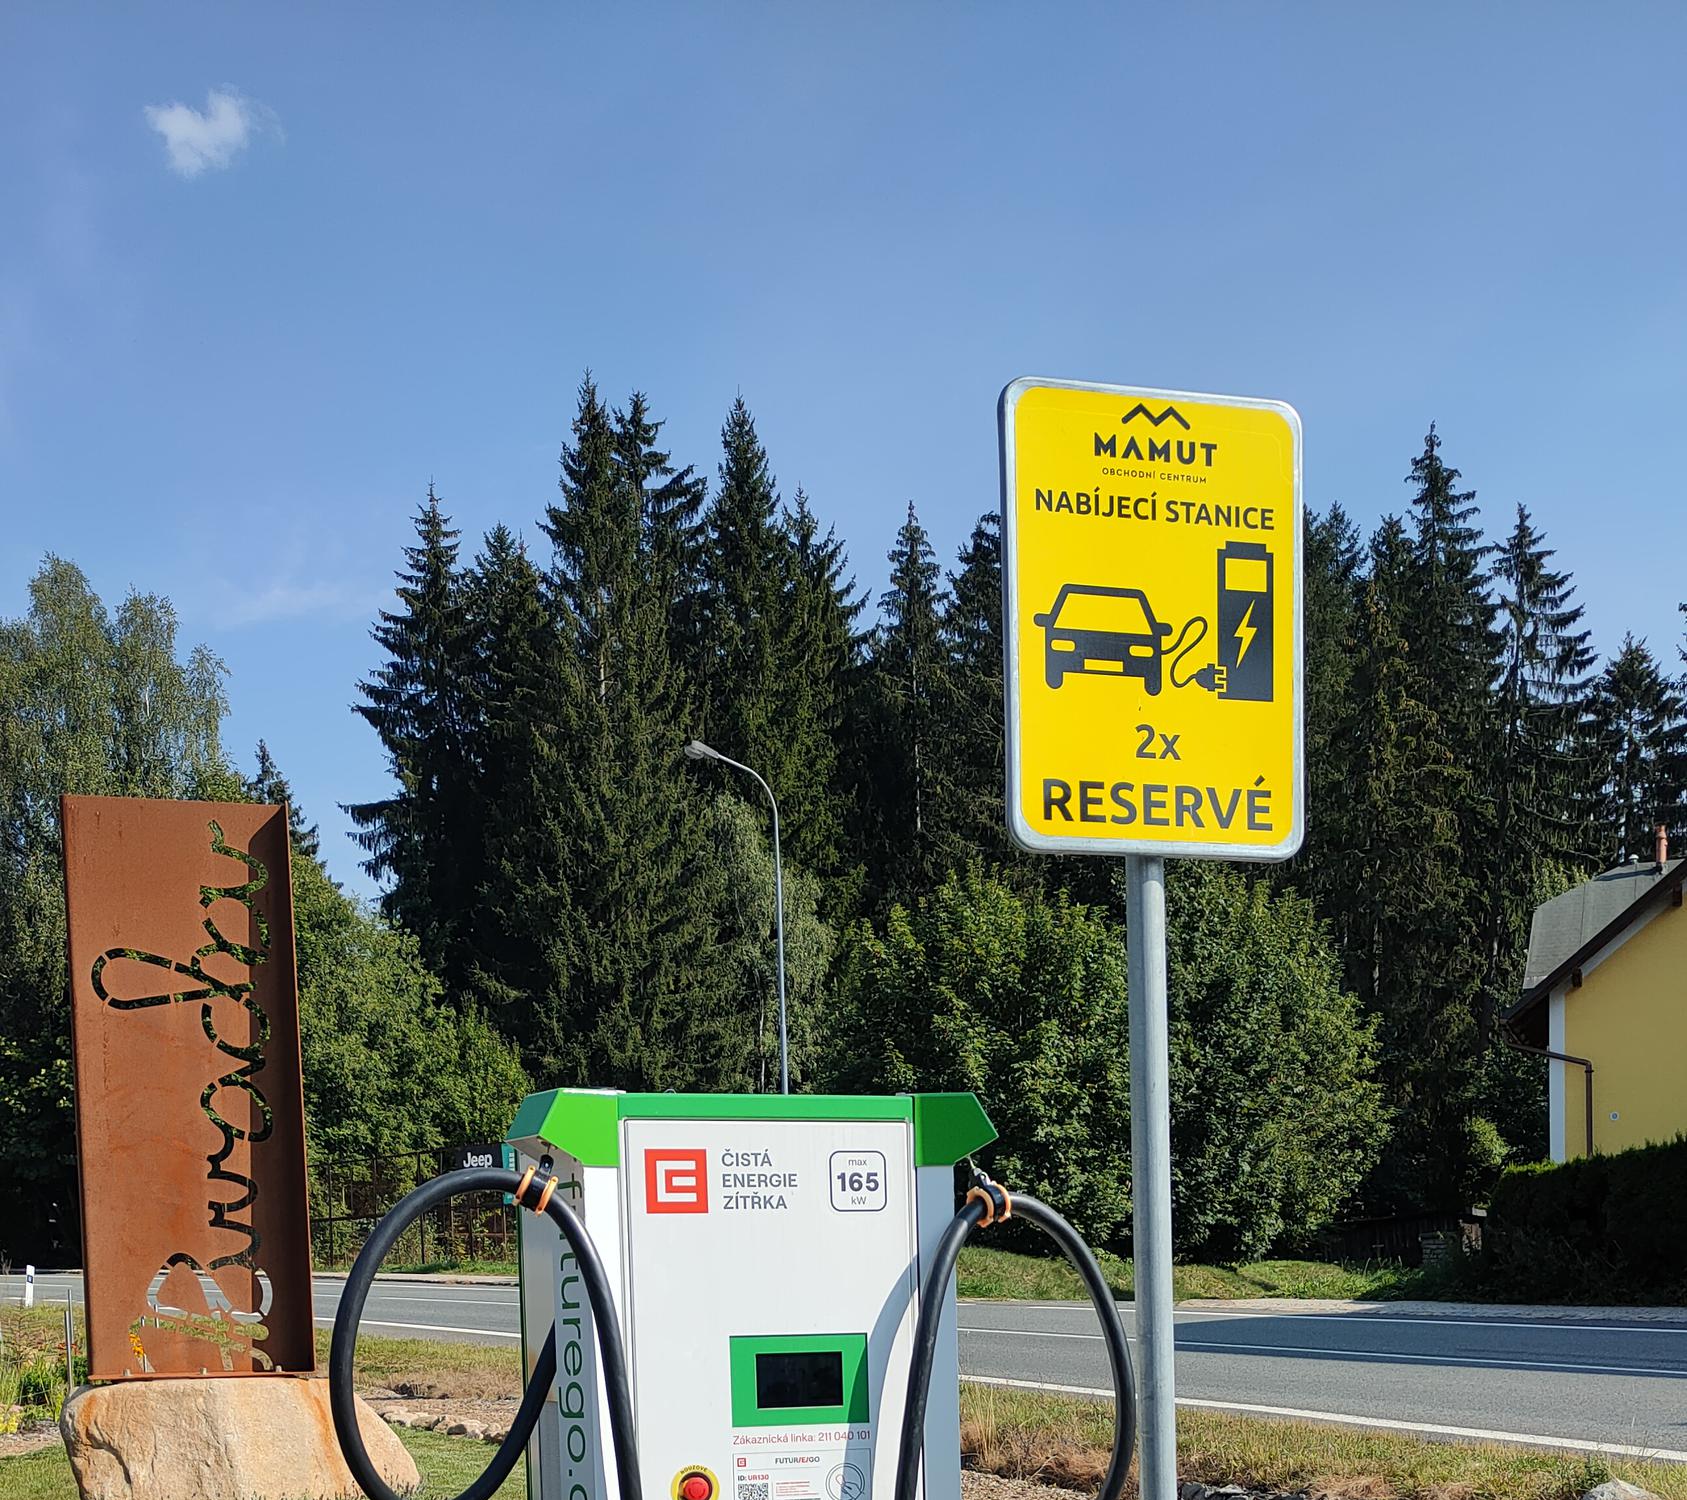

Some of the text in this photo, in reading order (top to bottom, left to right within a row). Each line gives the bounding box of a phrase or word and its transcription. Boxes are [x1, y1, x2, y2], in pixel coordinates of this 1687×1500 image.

[1094, 432, 1218, 467] MAMUT
[1101, 467, 1207, 484] OBCHODNÍ CENTRUM
[1035, 486, 1275, 531] NABÍJECÍ STANICE
[1135, 724, 1182, 761] 2x
[1042, 775, 1274, 832] RESERVÉ
[463, 1152, 493, 1168] Jeep
[721, 1149, 772, 1167] ČISTÁ
[848, 1158, 867, 1166] max
[722, 1173, 798, 1188] ENERGIE
[837, 1172, 879, 1192] 165
[723, 1191, 788, 1210] ZÍTŘKA
[851, 1196, 867, 1205] kW
[733, 1430, 870, 1445] Zákaznická linka: 211 040 101
